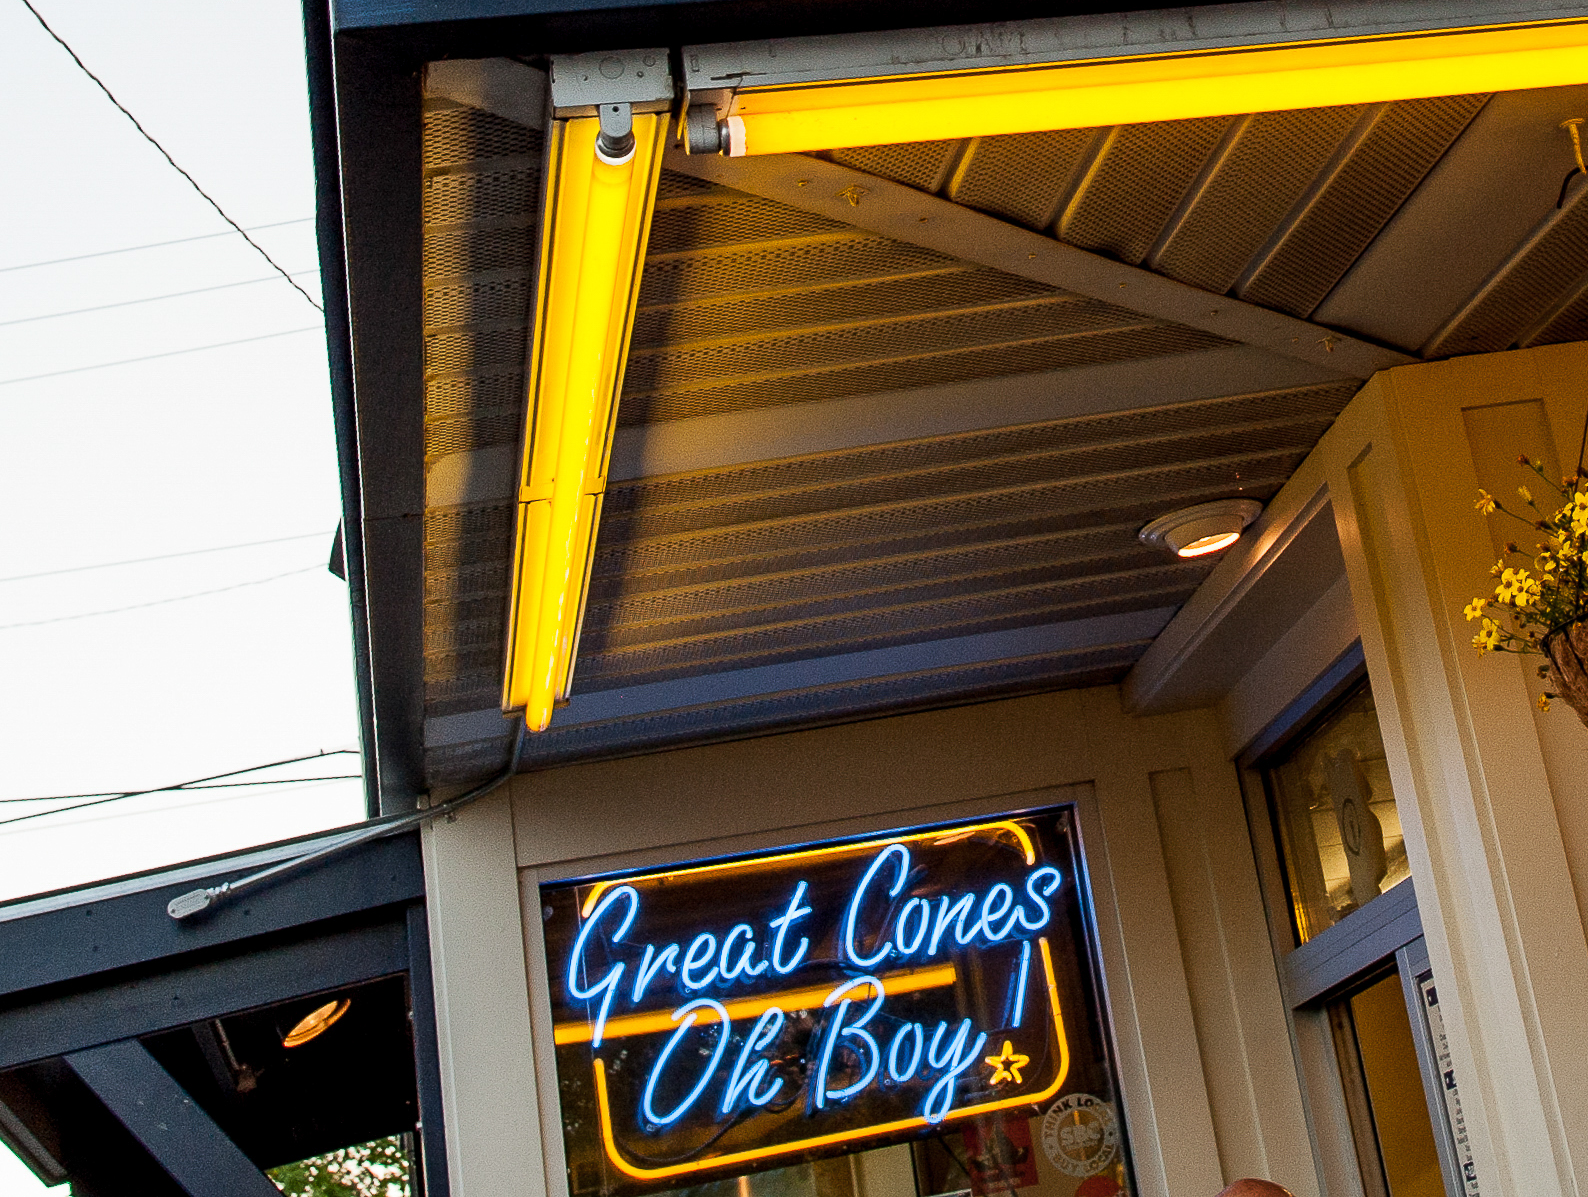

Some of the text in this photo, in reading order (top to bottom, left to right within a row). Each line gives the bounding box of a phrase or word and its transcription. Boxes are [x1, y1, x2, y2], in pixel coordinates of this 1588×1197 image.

[567, 843, 1062, 1049] Great Cones
[643, 998, 784, 1127] Oh
[1044, 1097, 1073, 1140] THINK
